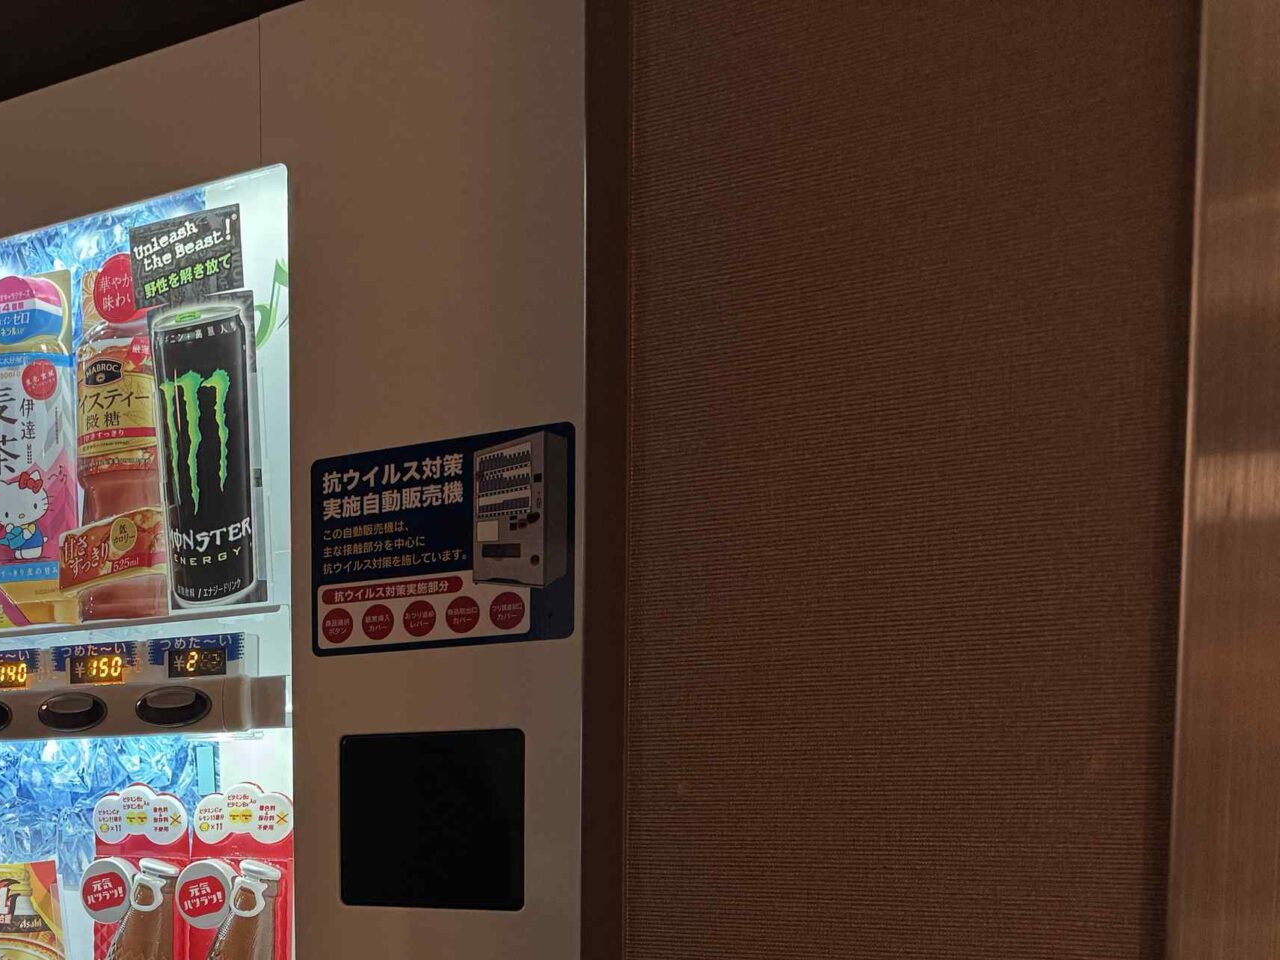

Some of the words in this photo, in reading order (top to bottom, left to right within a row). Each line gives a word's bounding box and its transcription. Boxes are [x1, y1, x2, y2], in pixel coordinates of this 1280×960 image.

[134, 221, 198, 260] Unleash
[144, 251, 172, 271] the
[175, 218, 231, 259] Beast!
[144, 253, 231, 299] 野性を解き放て
[79, 389, 149, 414] イスティー
[86, 412, 120, 431] 微糖
[322, 453, 464, 495] 抗ウイルス対策
[322, 480, 463, 520] 実施自動販売機
[323, 520, 409, 541] この自動販売機は、
[323, 536, 425, 558] 主な接触部分を中心に
[323, 548, 467, 575] 抗ウイルス対策を施しています。
[334, 581, 449, 602] 抗ウイルス対策実施部分
[369, 622, 388, 632] カバー
[409, 618, 429, 628] レバー
[453, 615, 472, 625] カバー
[497, 612, 518, 621] カバー
[92, 877, 112, 891] 元気
[188, 881, 211, 896] 元気
